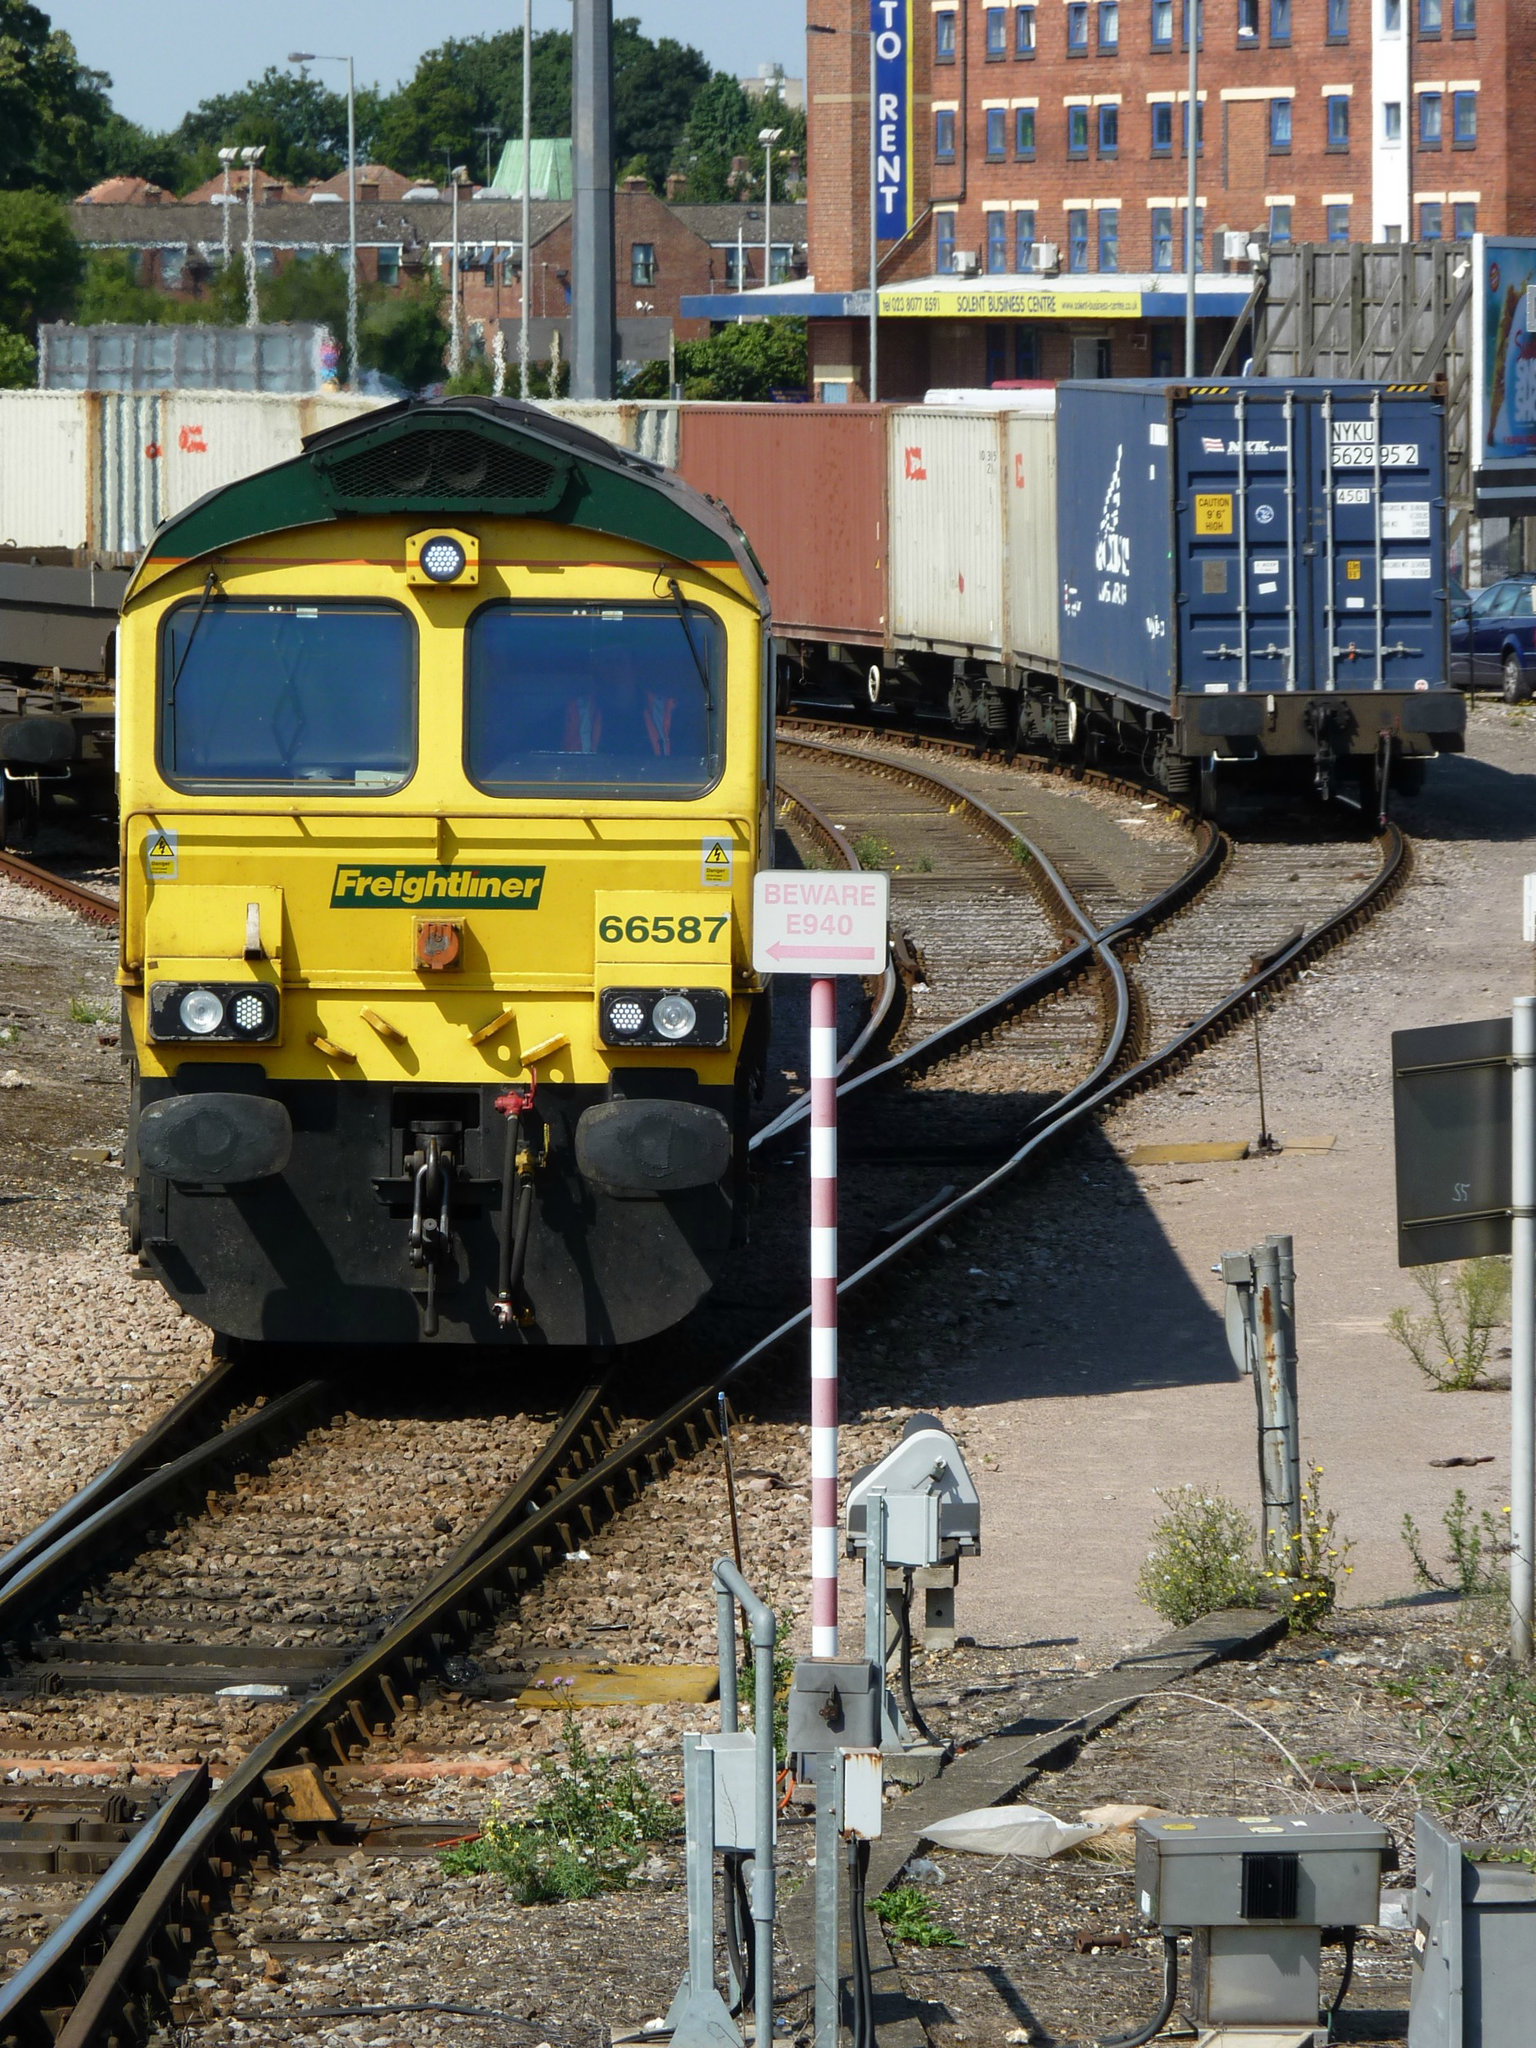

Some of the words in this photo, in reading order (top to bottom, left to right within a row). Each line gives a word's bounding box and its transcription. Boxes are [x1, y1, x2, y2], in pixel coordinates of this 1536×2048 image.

[875, 0, 902, 60] TO
[877, 93, 901, 214] RENT
[956, 295, 986, 313] SOLENT
[988, 295, 1025, 313] BUSINESS
[1027, 295, 1057, 313] CENTRE
[1331, 423, 1374, 441] NYKU
[1198, 498, 1230, 507] CAUTION
[1205, 521, 1224, 531] HIGH
[334, 868, 541, 904] Freightliner
[764, 883, 876, 907] BEWARE
[598, 915, 729, 944] 66587
[786, 913, 853, 936] E940
